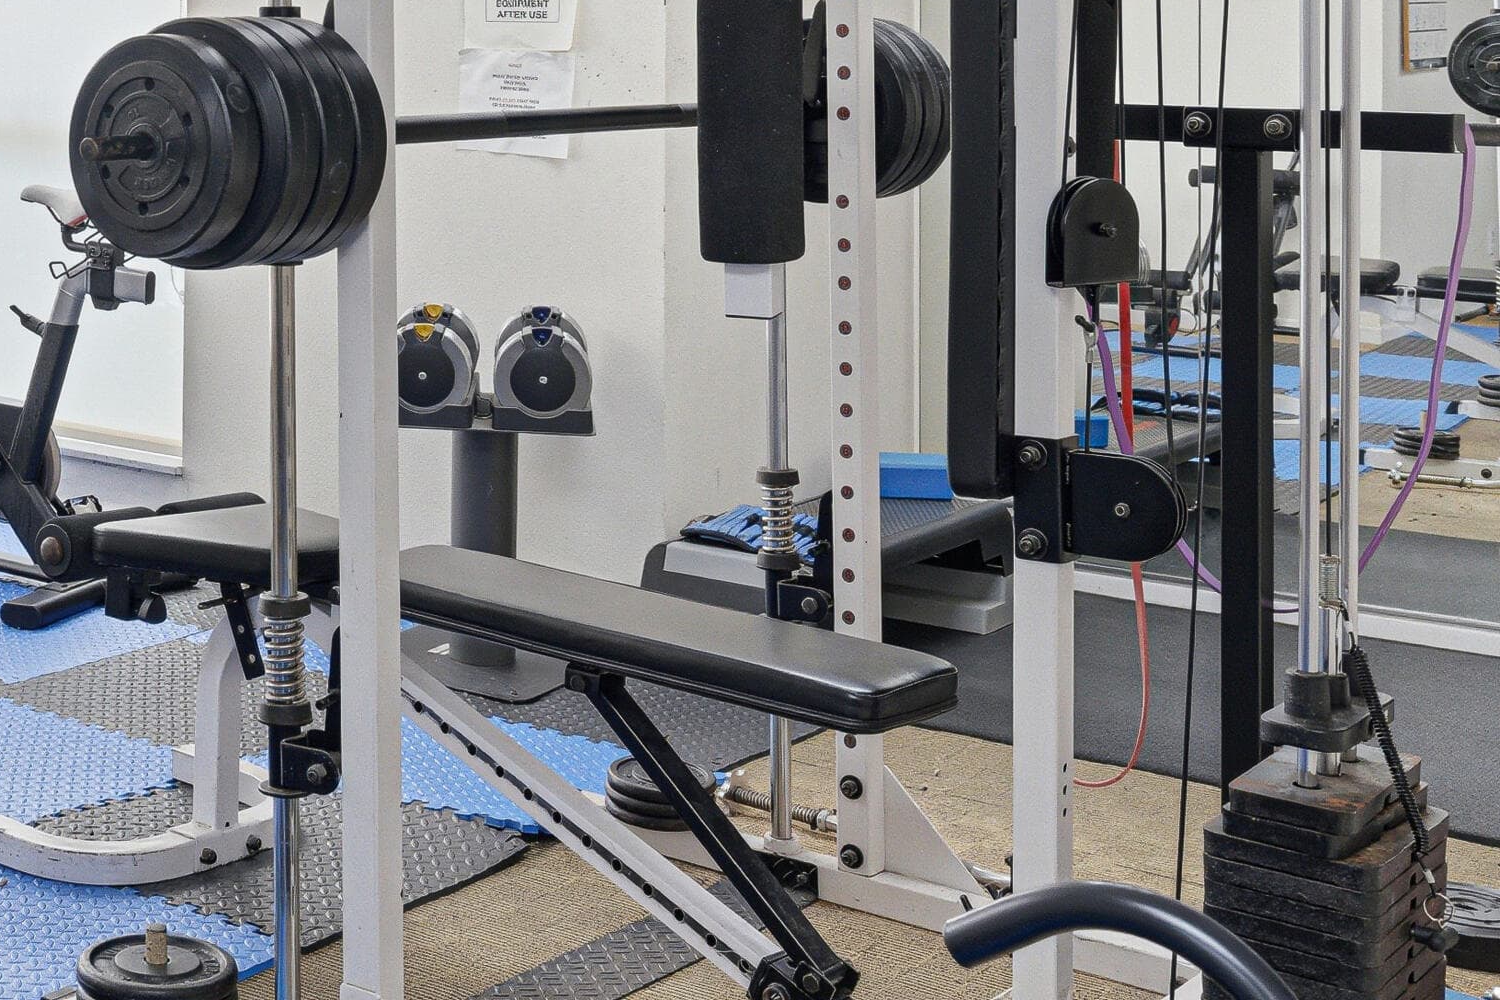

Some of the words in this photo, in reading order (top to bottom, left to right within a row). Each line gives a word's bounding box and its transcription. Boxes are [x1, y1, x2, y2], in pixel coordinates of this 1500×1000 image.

[496, 0, 550, 8] EQUIPMENT
[497, 10, 527, 19] AFTER
[529, 10, 548, 19] USE
